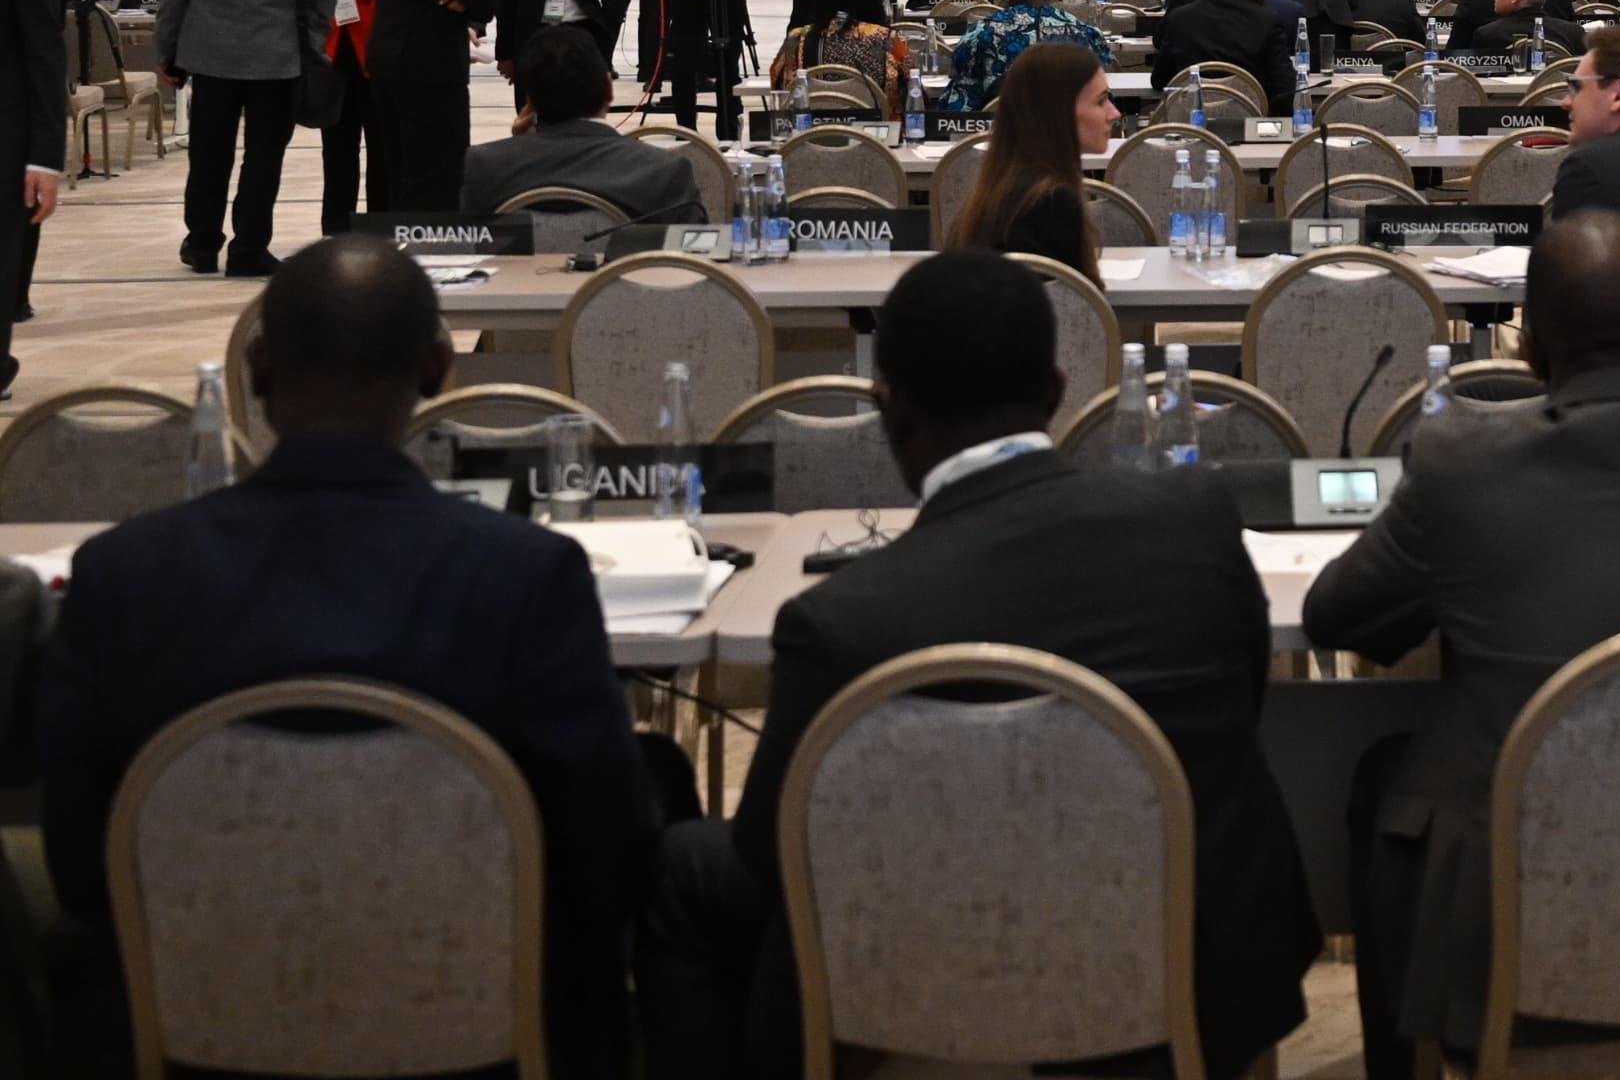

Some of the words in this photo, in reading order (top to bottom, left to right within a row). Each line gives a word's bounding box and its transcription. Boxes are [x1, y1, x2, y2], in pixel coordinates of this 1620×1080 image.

[1336, 58, 1375, 66] KENYA
[938, 119, 994, 132] PALEST
[1501, 115, 1544, 127] OMAN
[395, 225, 493, 243] ROMANIA
[787, 220, 894, 240] ROMANIA
[1381, 223, 1440, 234] RUSSIAN
[1444, 223, 1528, 234] FEDERATION
